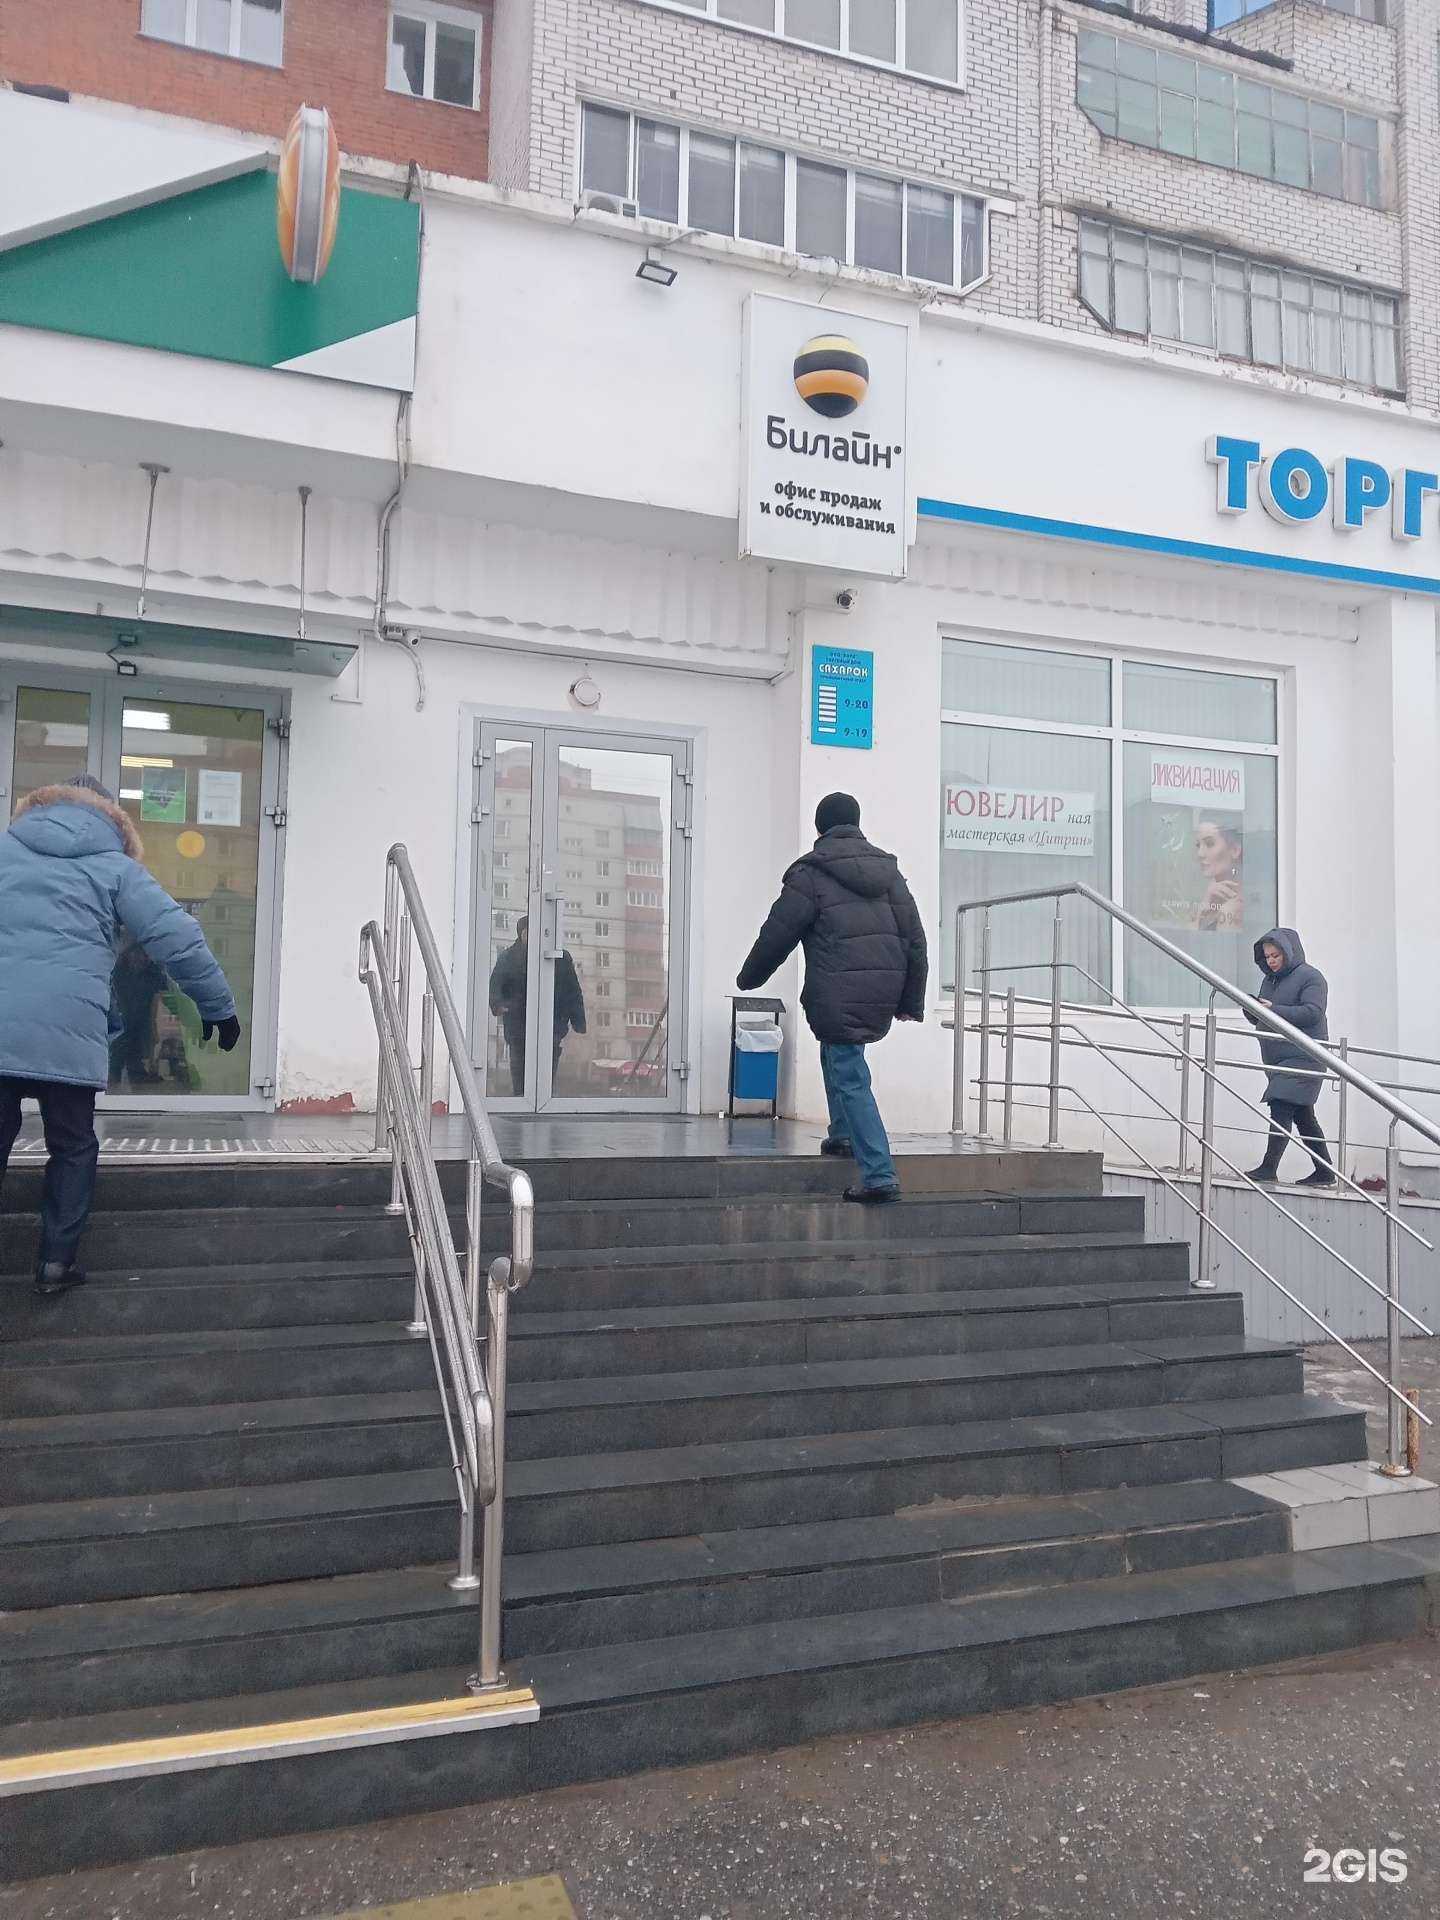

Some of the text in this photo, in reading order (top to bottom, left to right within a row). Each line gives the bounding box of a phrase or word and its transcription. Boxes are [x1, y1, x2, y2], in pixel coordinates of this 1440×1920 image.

[774, 480, 882, 511] офис продаж
[760, 500, 896, 534] и обслуживания
[819, 663, 868, 678] САХАРОК
[946, 788, 1092, 825] ЮВЕЛИР ная
[946, 828, 1025, 846] мастерская
